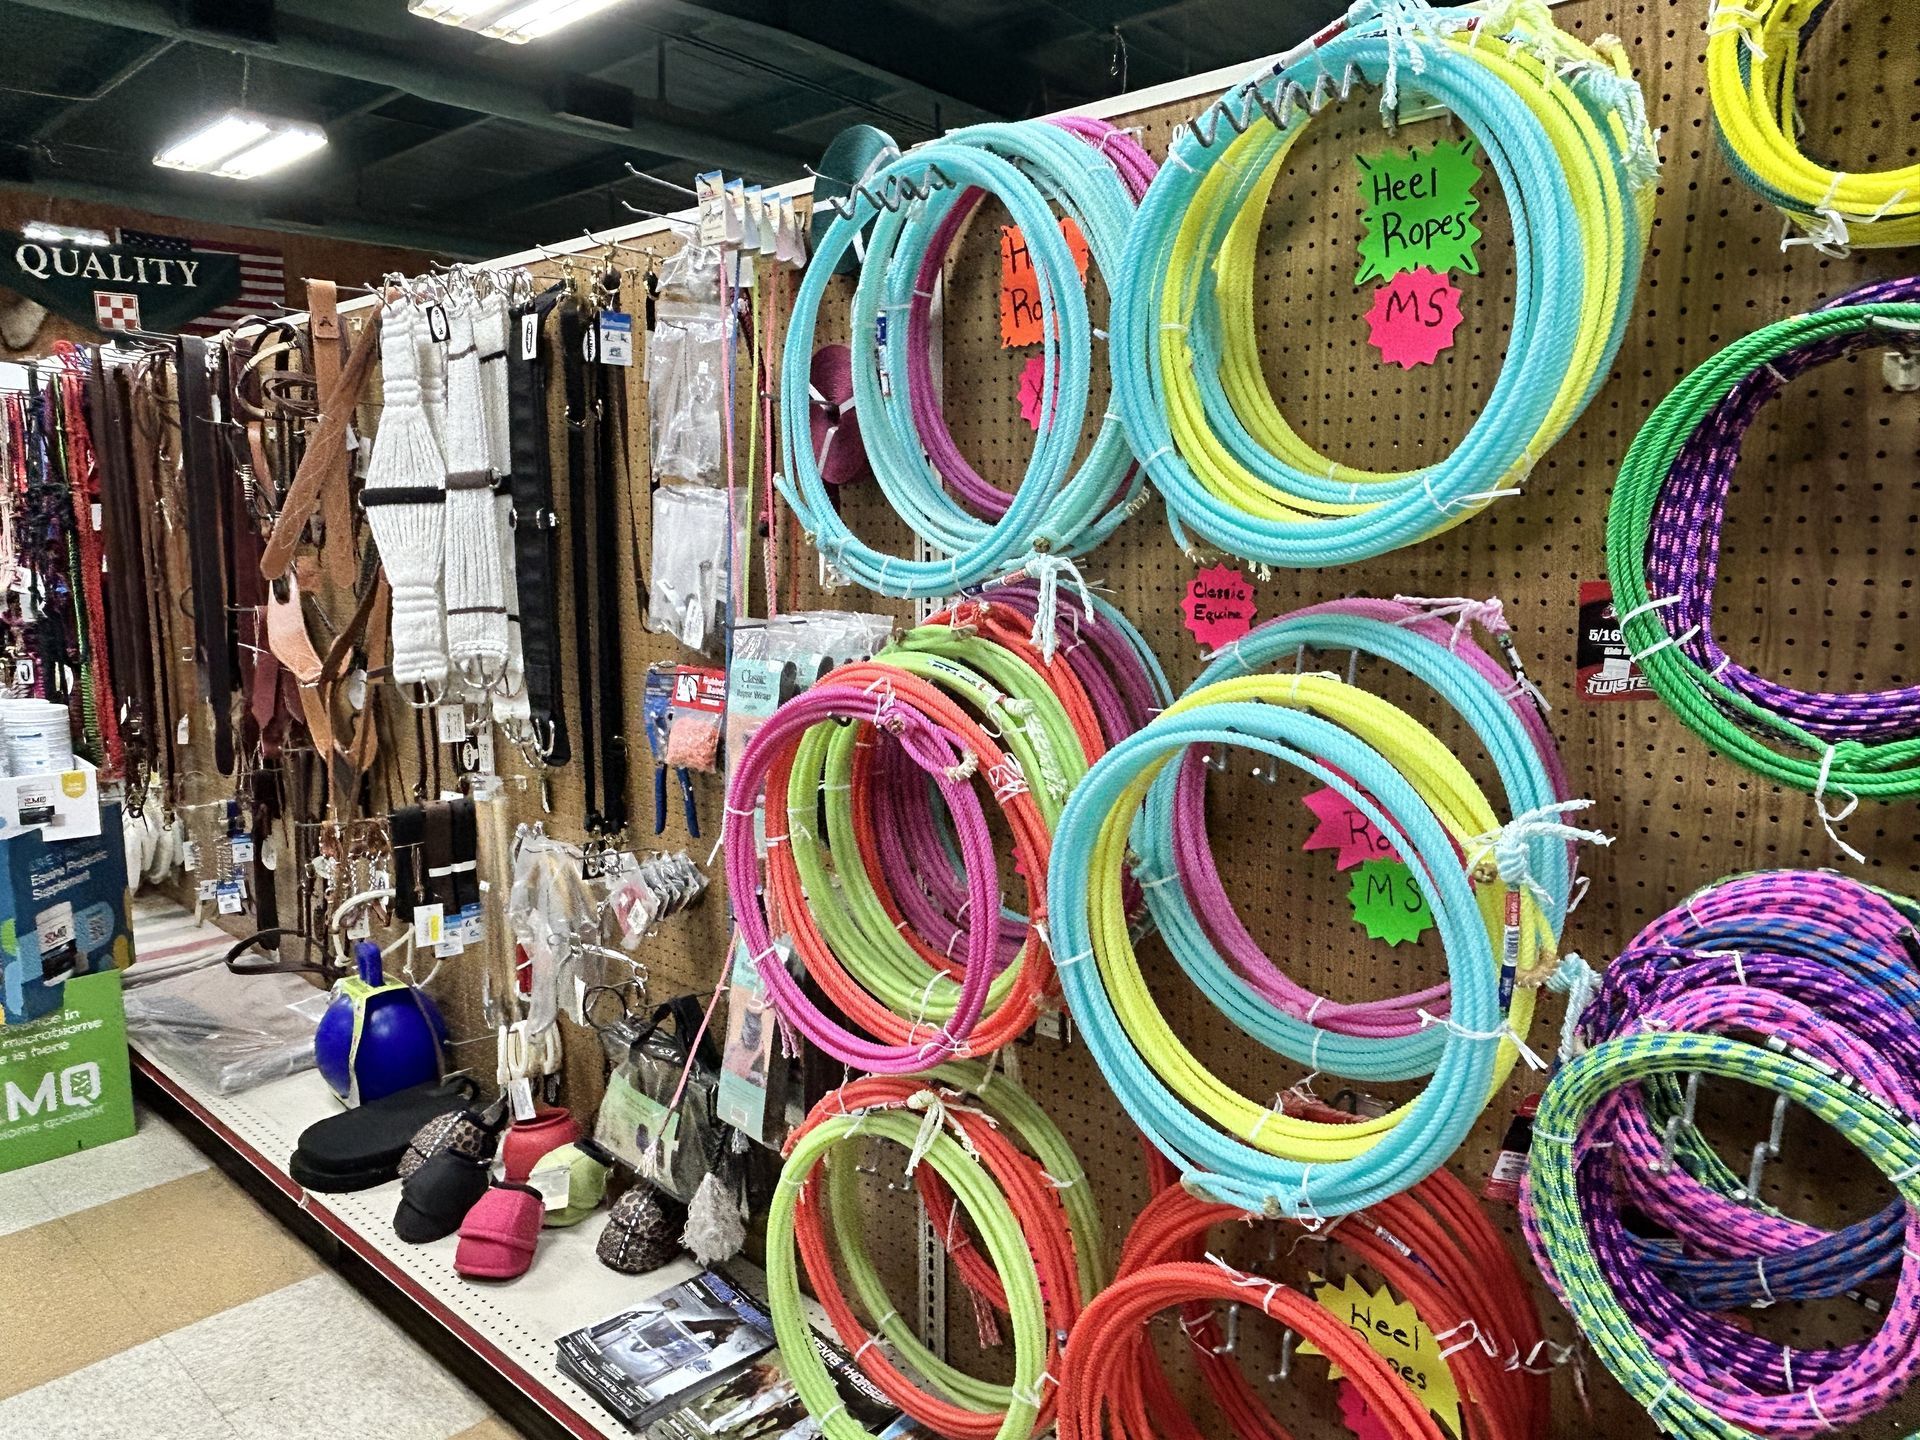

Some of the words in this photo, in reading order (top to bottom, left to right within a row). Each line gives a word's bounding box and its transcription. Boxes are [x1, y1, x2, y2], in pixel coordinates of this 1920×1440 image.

[1373, 167, 1438, 206] Heel
[1382, 211, 1466, 258] Ropes
[15, 243, 199, 288] QUALITY
[1386, 287, 1448, 328] MS
[1193, 581, 1246, 601] Classic
[1194, 603, 1243, 625] Equine
[1367, 873, 1423, 912] MS
[31, 1040, 70, 1058] here
[1351, 1303, 1420, 1351] Heel
